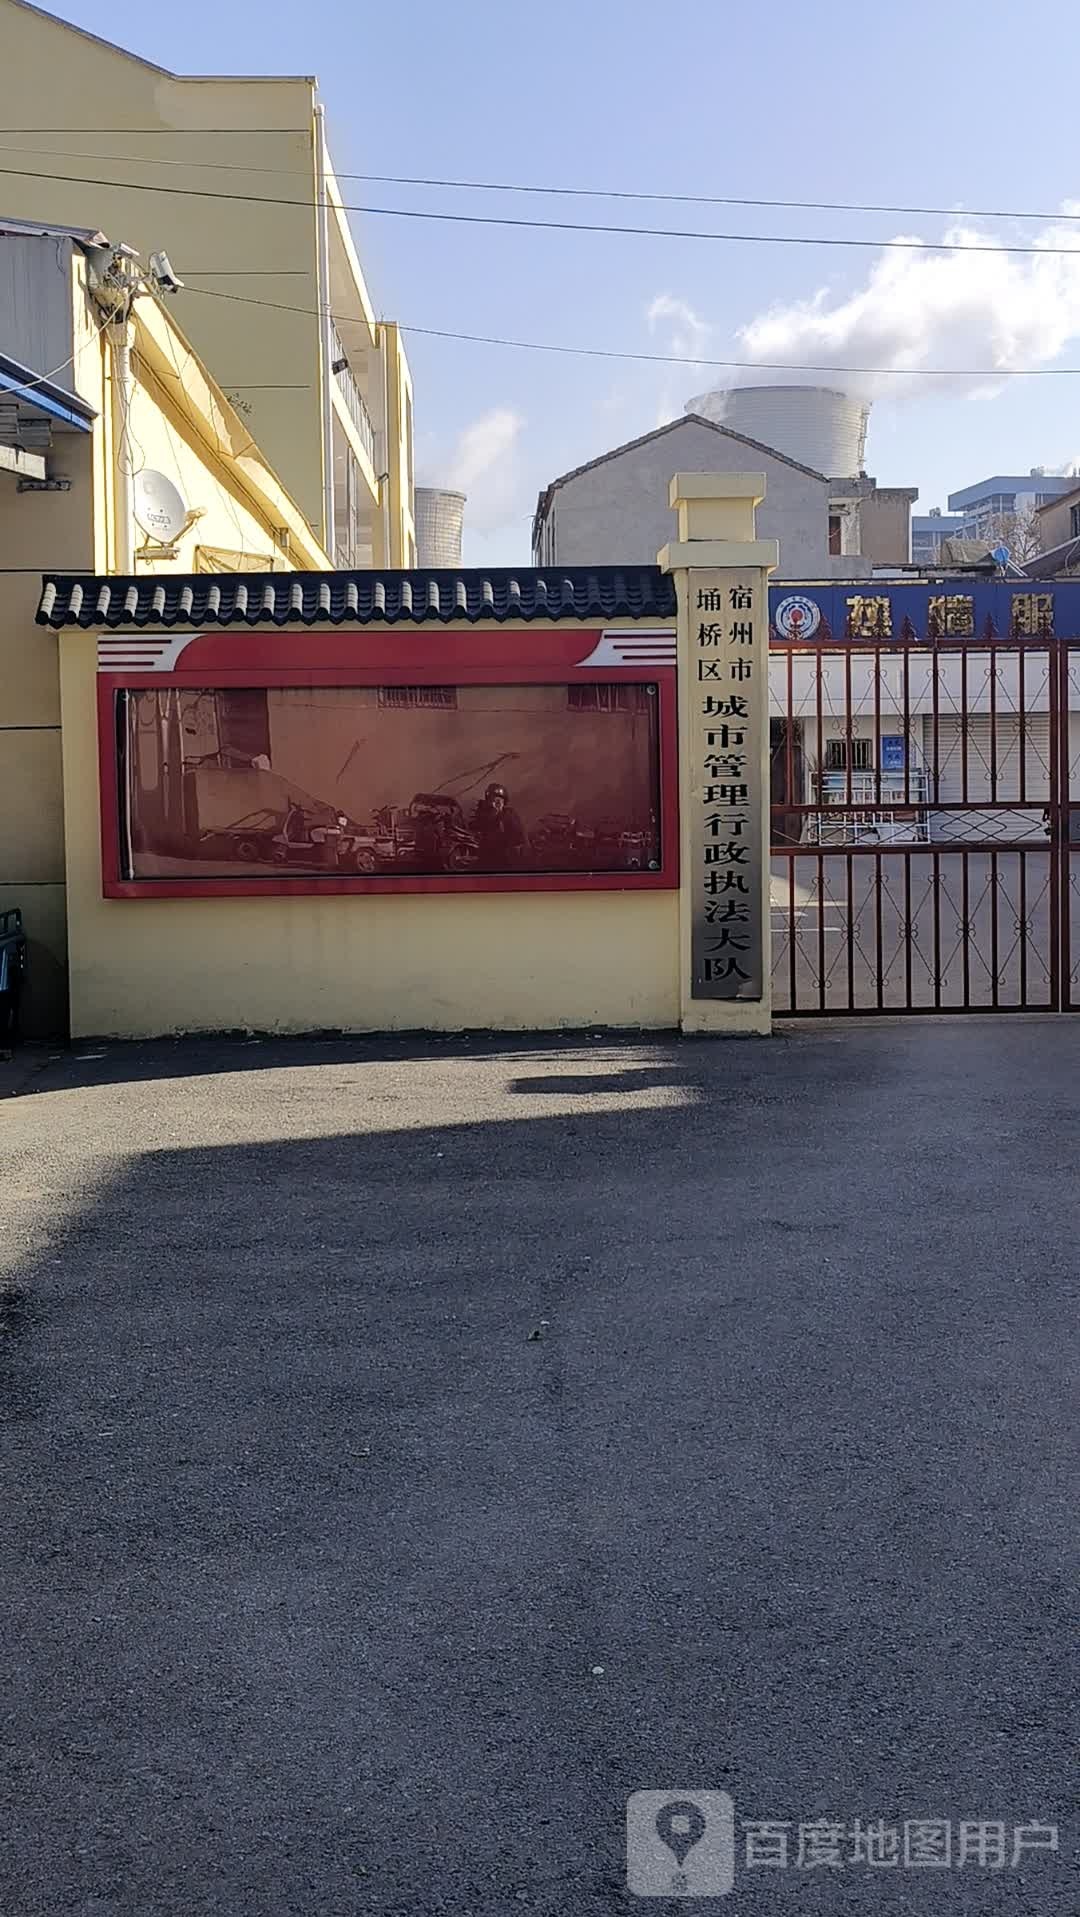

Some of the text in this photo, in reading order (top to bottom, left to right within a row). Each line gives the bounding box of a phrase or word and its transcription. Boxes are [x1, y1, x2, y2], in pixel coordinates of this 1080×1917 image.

[696, 587, 722, 682] 埇桥区
[728, 584, 753, 682] 宿州市
[702, 695, 752, 982] 城市管理行政执法大队
